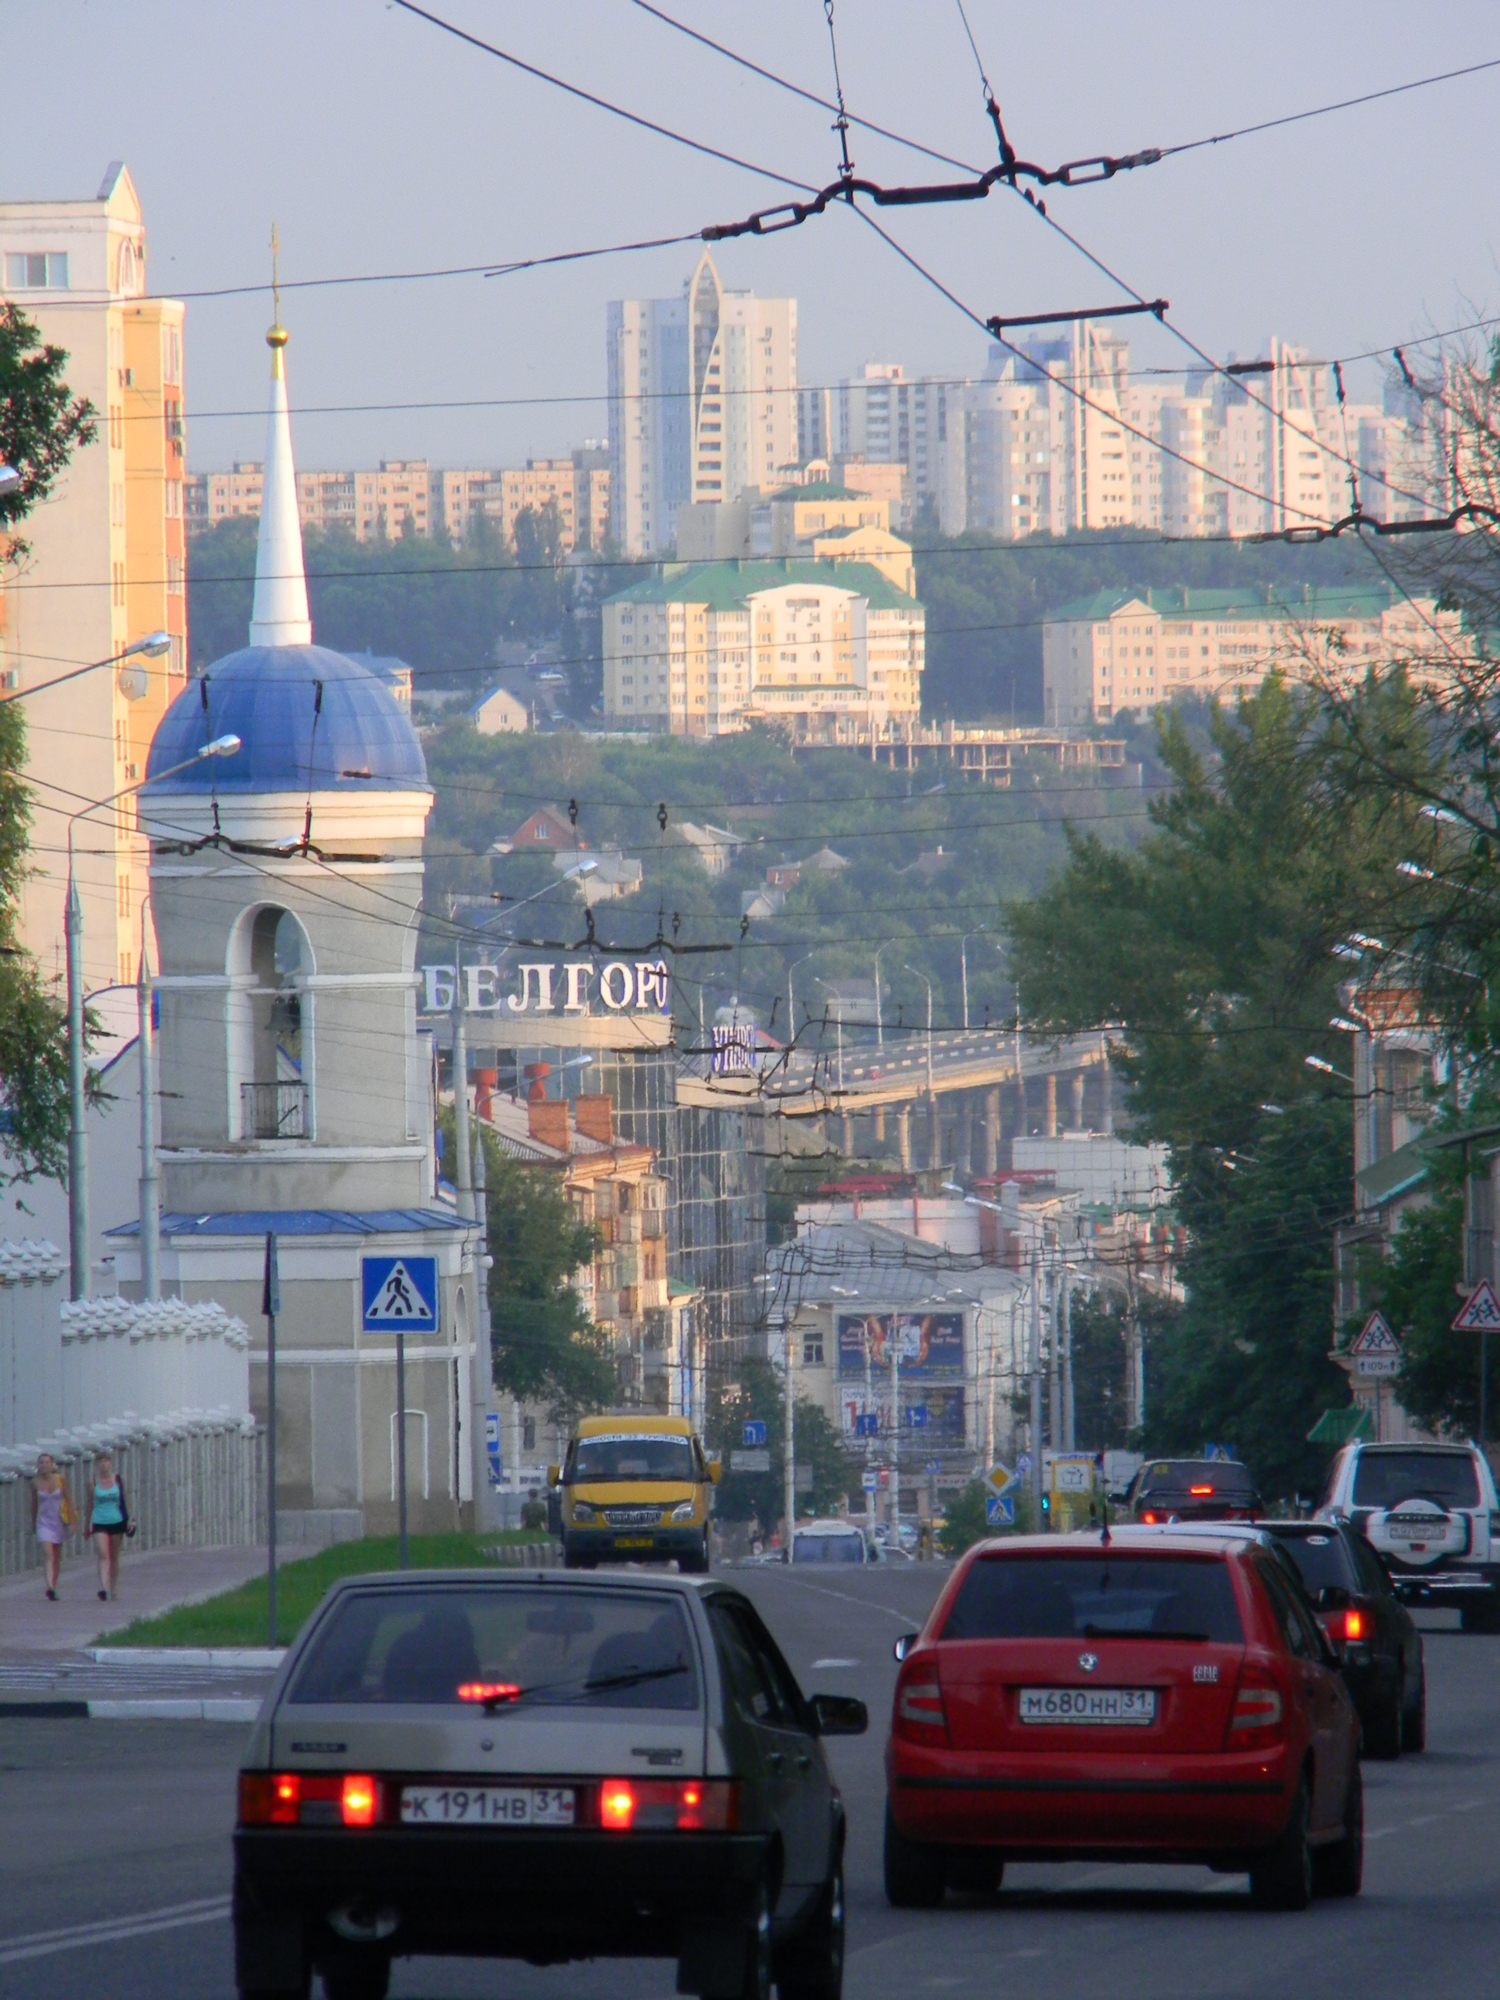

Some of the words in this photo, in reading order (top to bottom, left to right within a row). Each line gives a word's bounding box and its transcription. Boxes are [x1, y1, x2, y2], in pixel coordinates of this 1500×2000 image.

[1124, 1692, 1145, 1708] 31
[413, 1791, 527, 1819] К191НВ
[536, 1790, 564, 1812] 31
